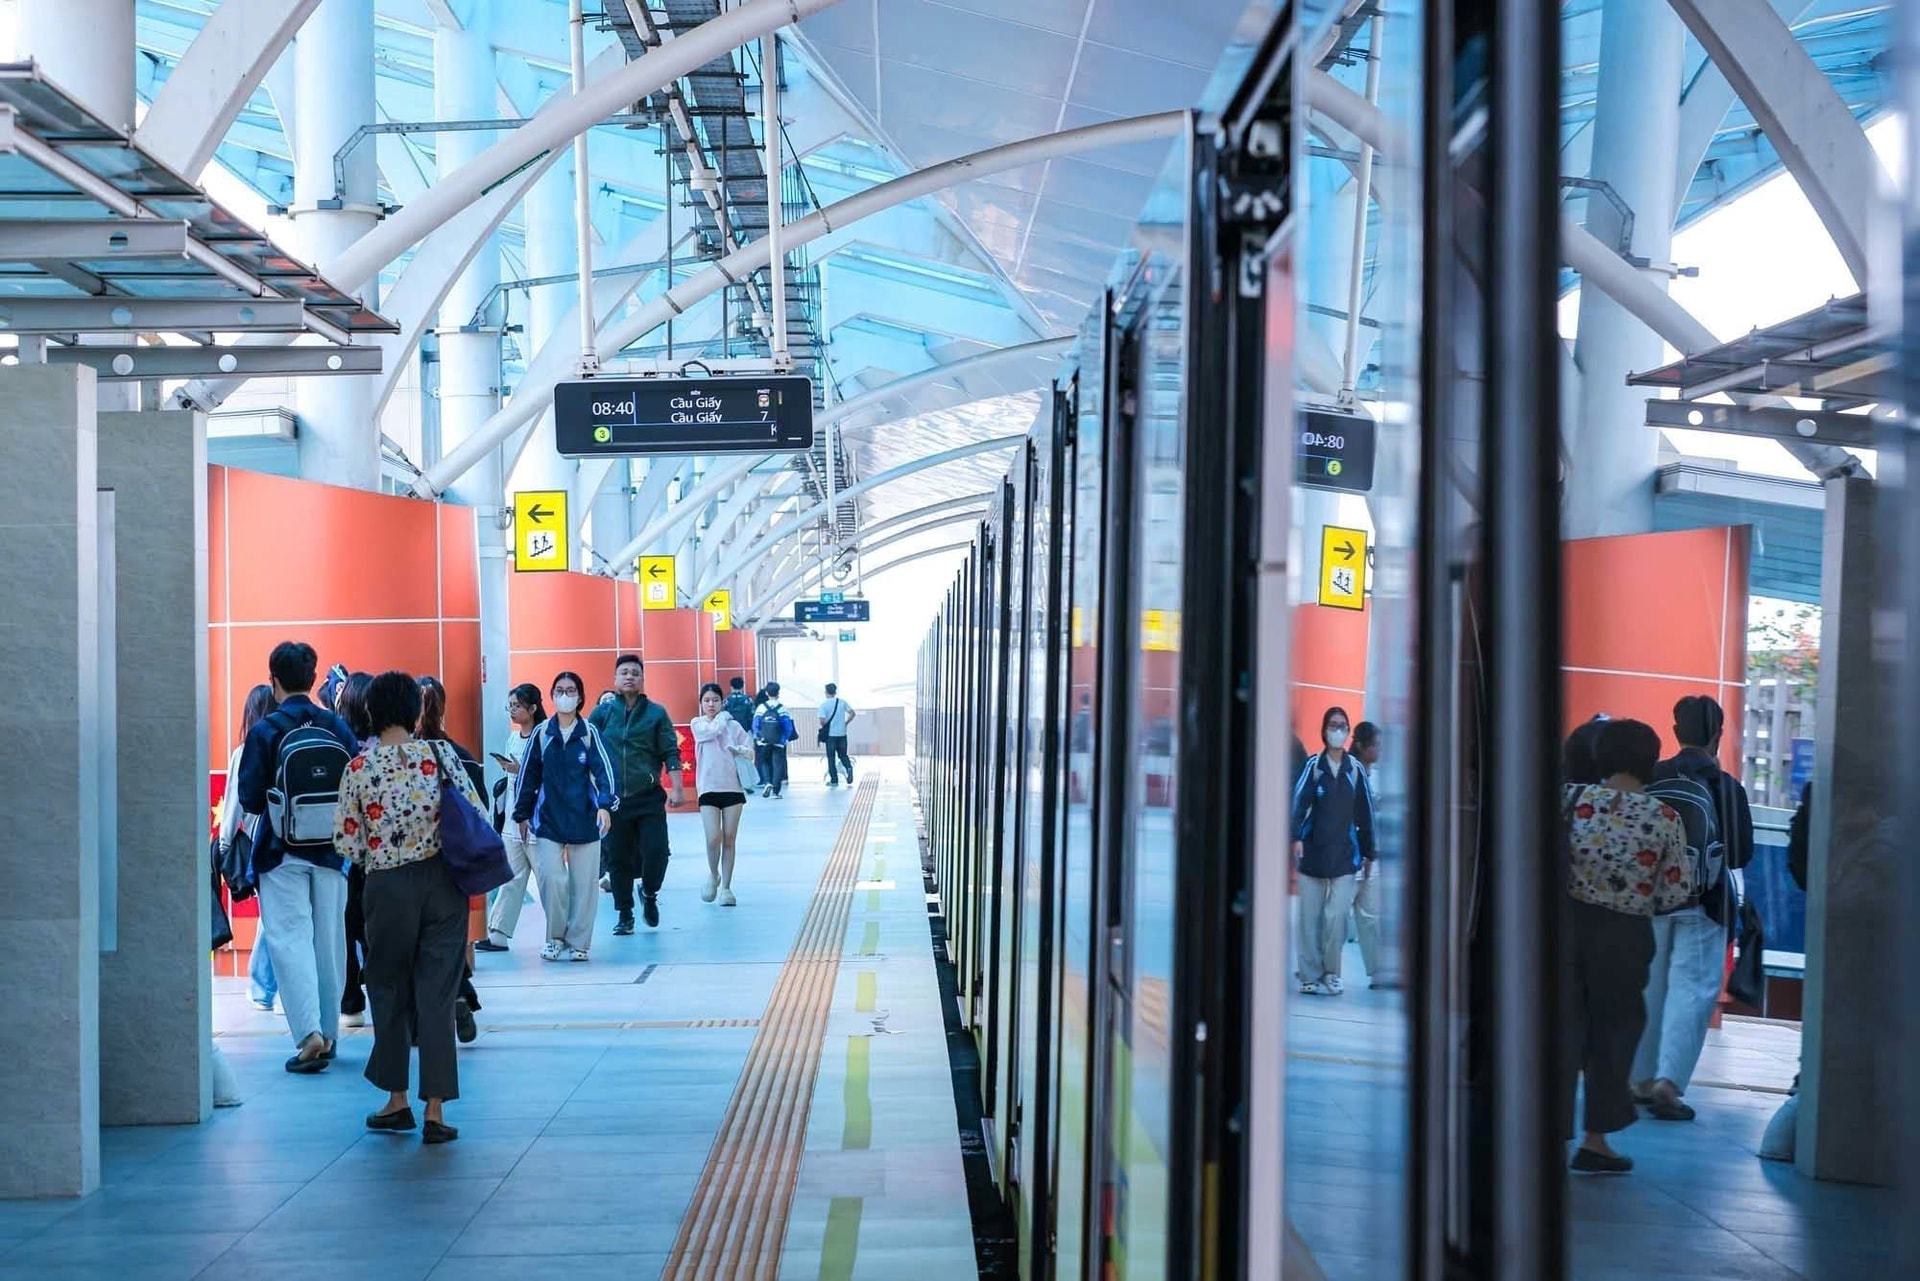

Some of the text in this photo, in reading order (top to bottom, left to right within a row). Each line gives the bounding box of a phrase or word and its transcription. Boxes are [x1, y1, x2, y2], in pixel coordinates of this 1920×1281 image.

[592, 401, 634, 415] 08:40
[670, 396, 722, 411] Cầu Giấy
[671, 411, 723, 423] Cầu Giấy
[760, 410, 769, 422] 7
[599, 429, 606, 439] 3
